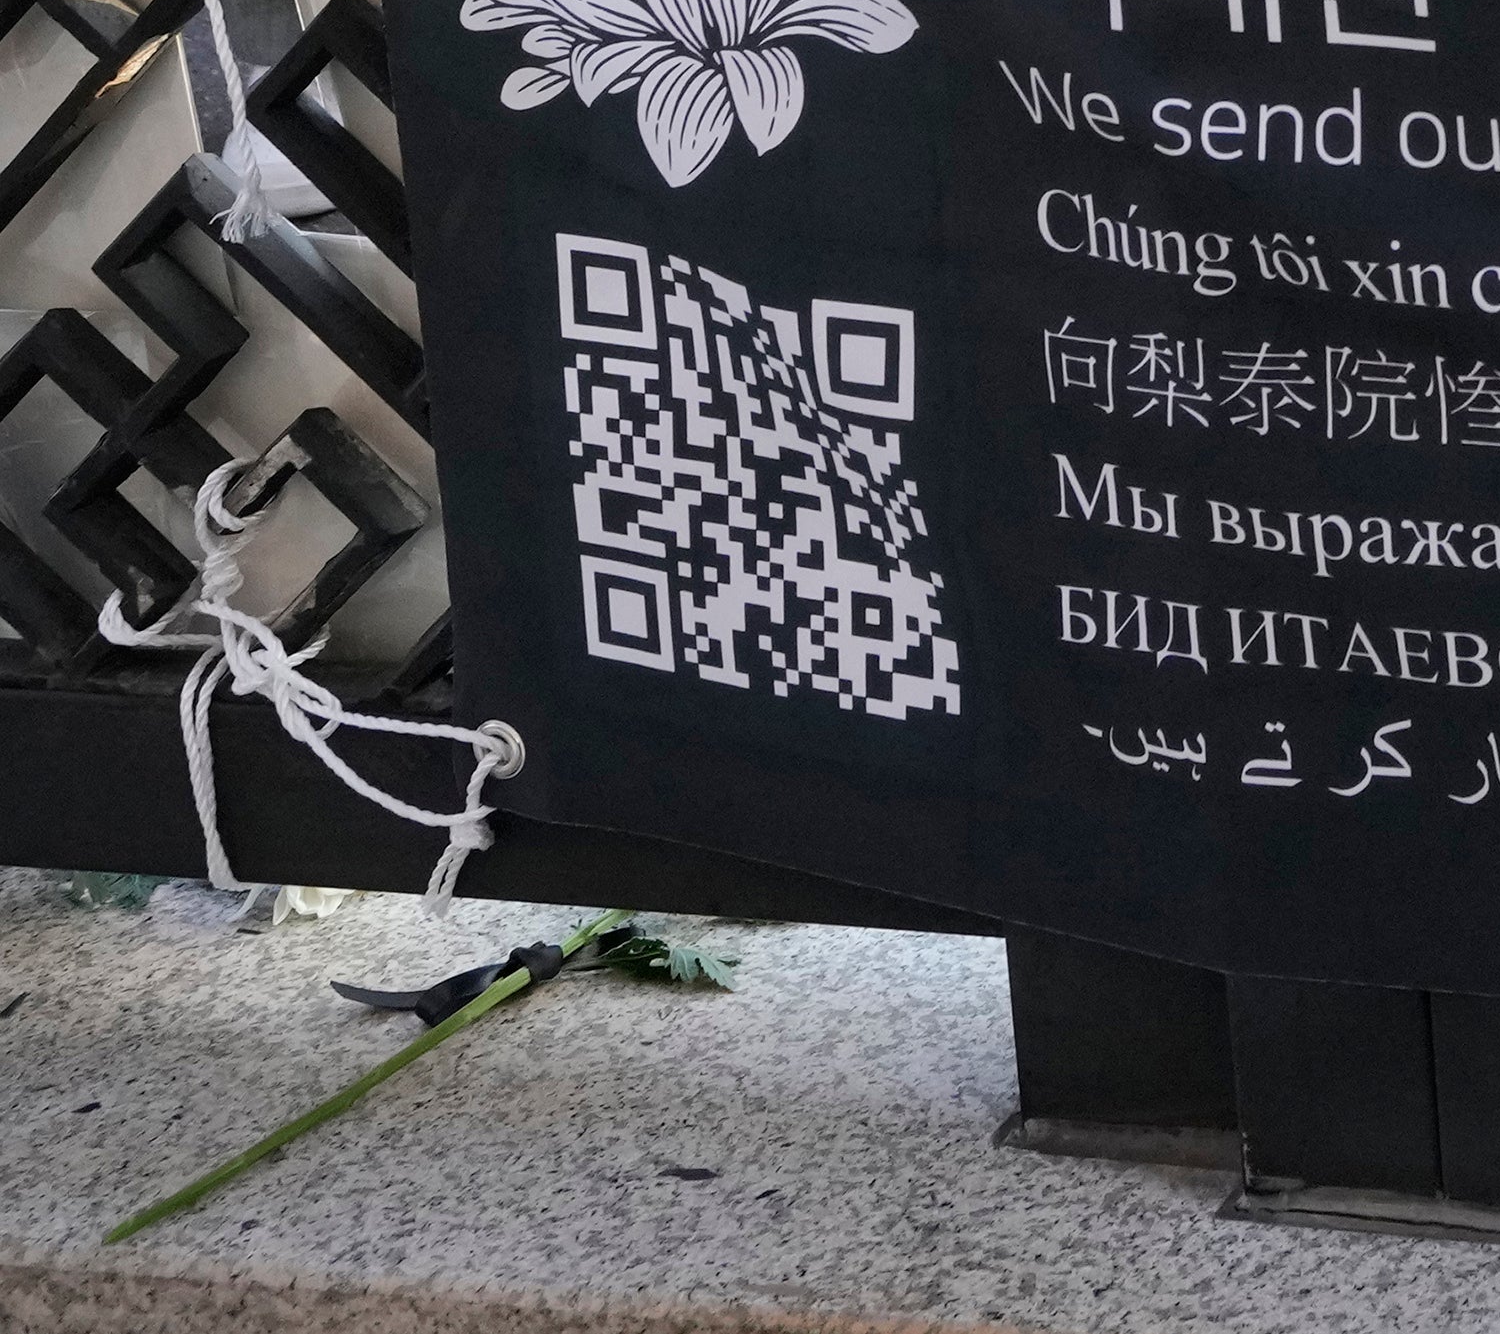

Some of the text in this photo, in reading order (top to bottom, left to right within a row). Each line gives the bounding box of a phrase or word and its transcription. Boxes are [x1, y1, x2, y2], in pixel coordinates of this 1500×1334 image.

[998, 60, 1127, 144] We
[1151, 86, 1364, 168] send
[1037, 188, 1237, 299] Chúng
[1249, 232, 1331, 294] tôi
[1344, 239, 1453, 311] xin
[1052, 453, 1182, 541] Мы
[1056, 584, 1210, 676] БИД
